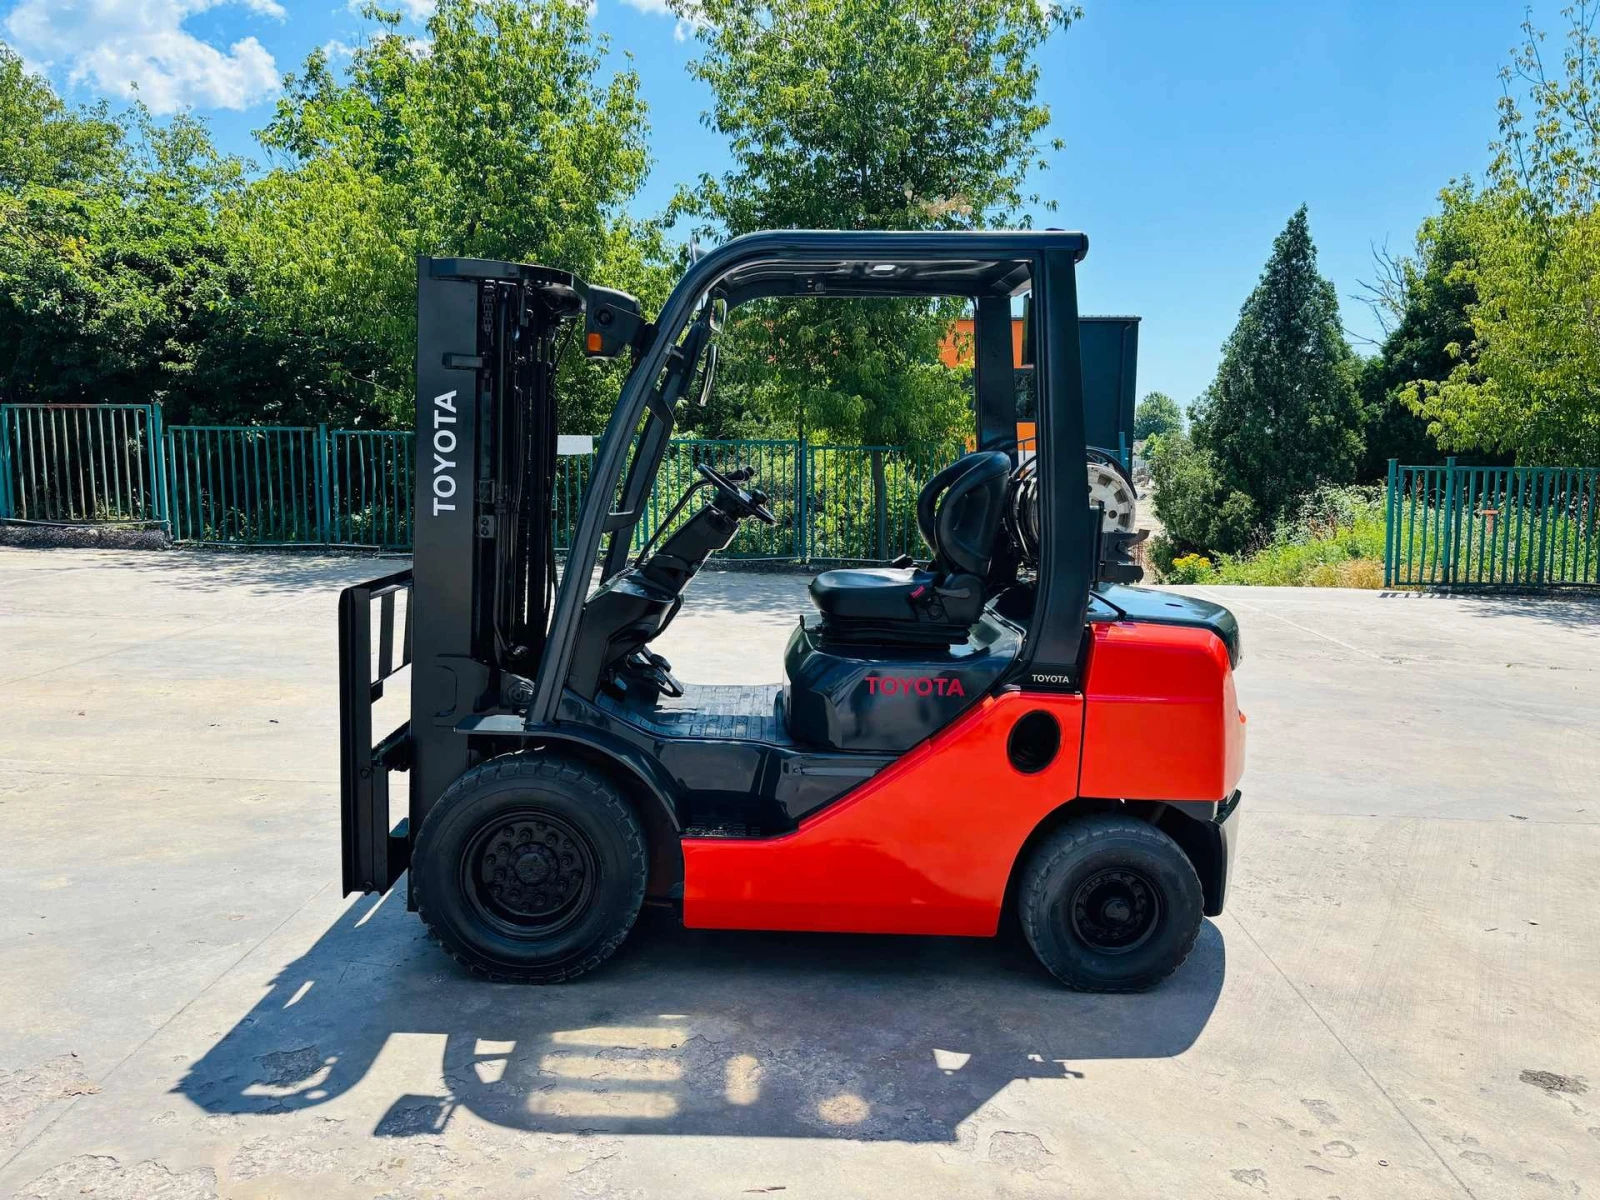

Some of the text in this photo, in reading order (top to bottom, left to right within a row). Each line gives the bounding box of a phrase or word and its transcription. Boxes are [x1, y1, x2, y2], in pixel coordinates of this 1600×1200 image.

[433, 390, 457, 516] TOYOTA
[865, 676, 965, 697] TOYOTA
[1032, 674, 1070, 684] TOYOTA
